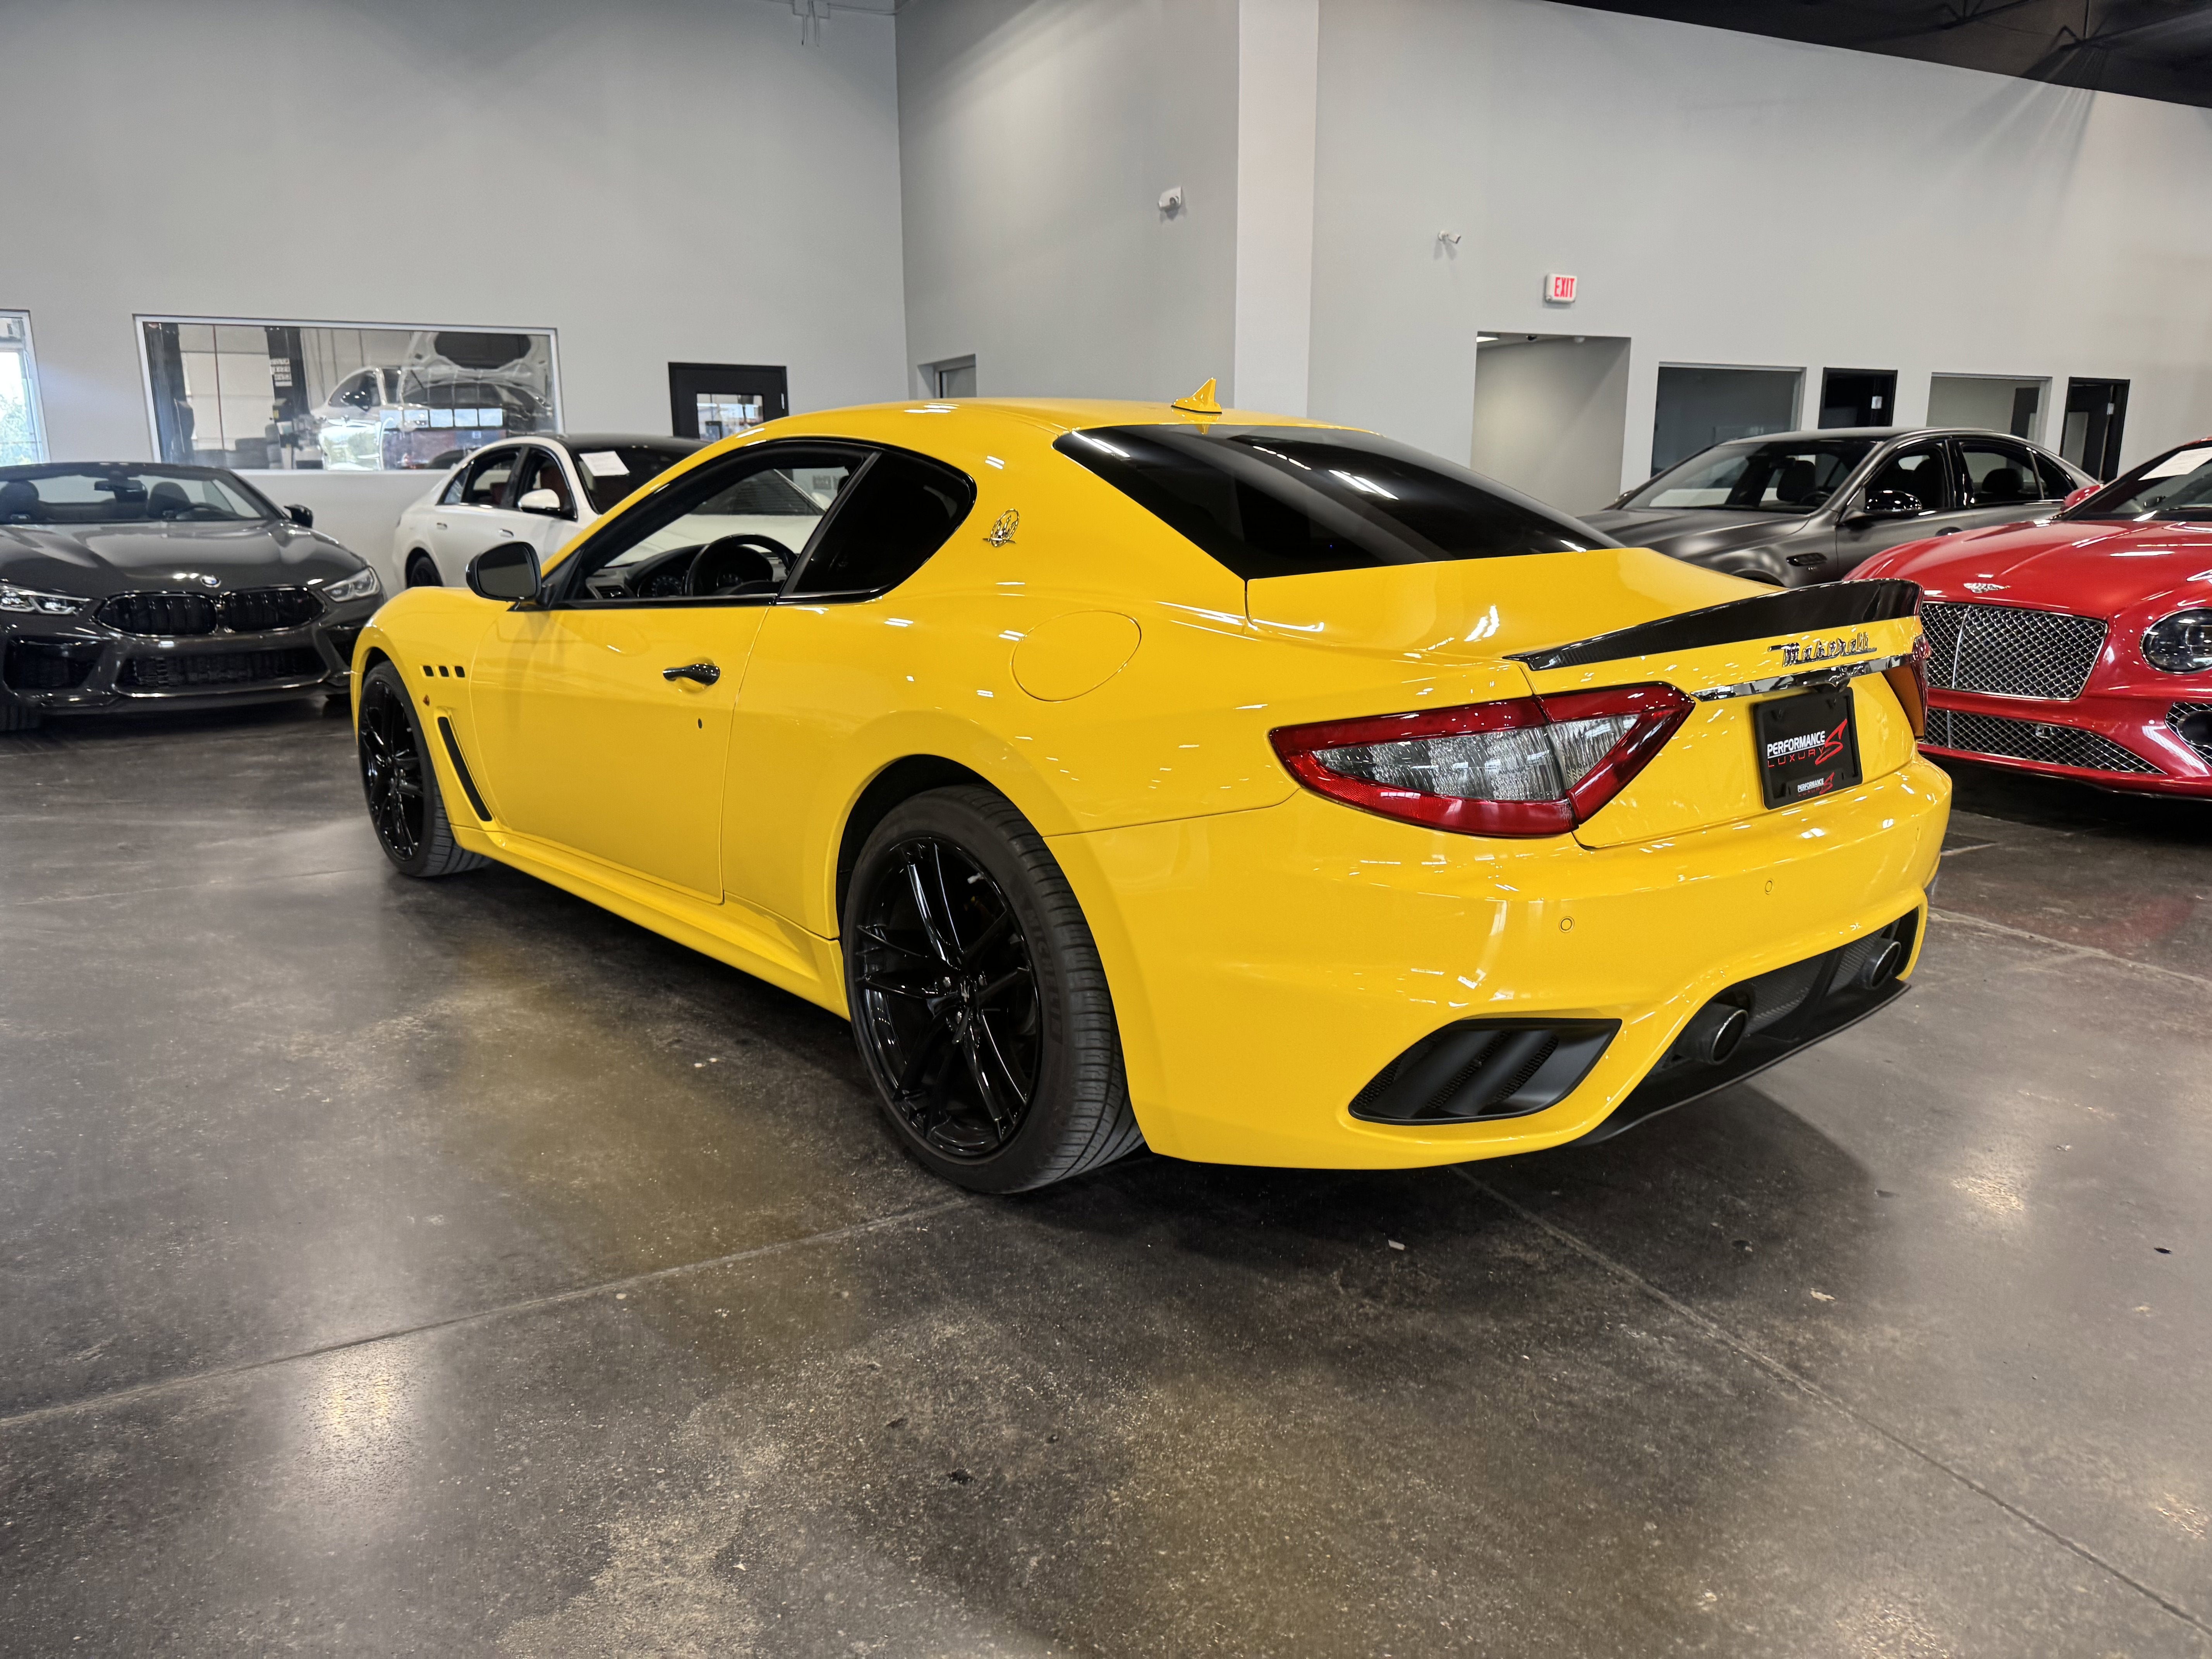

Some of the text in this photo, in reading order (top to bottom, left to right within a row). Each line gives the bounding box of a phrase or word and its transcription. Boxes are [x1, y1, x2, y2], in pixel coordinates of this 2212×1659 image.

[1554, 277, 1575, 298] EXIT
[1767, 730, 1825, 757] PERFORMANCE
[1767, 746, 1824, 768] LUXURY
